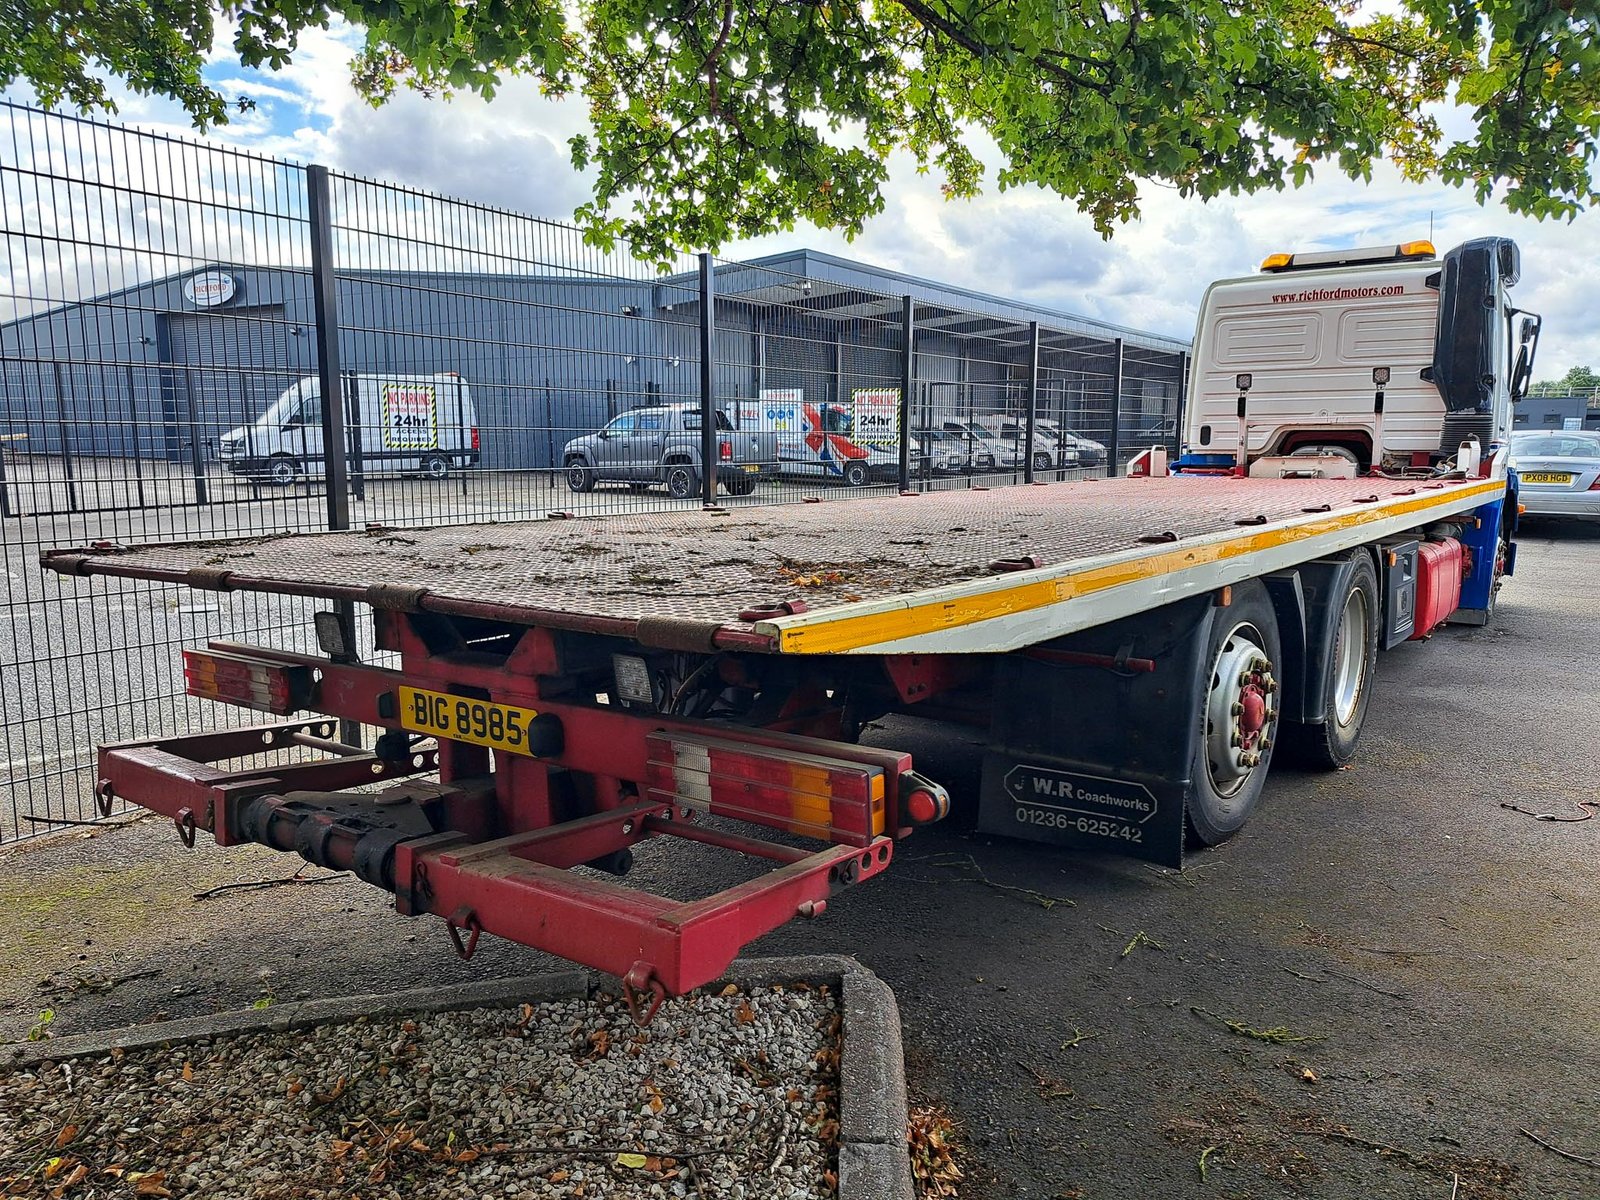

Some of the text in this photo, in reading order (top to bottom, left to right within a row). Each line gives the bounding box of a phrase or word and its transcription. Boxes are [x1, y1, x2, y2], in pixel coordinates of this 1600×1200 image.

[1272, 285, 1404, 303] www.richfordmotors.com
[400, 392, 431, 406] PARKING
[394, 414, 428, 427] 24hr
[860, 415, 892, 426] 24hr
[1525, 474, 1568, 482] PX08 HGD
[413, 692, 522, 745] BIG 8985
[1033, 777, 1073, 798] W.R
[1077, 789, 1150, 812] Coachworks
[1016, 807, 1143, 843] 01236-625242
